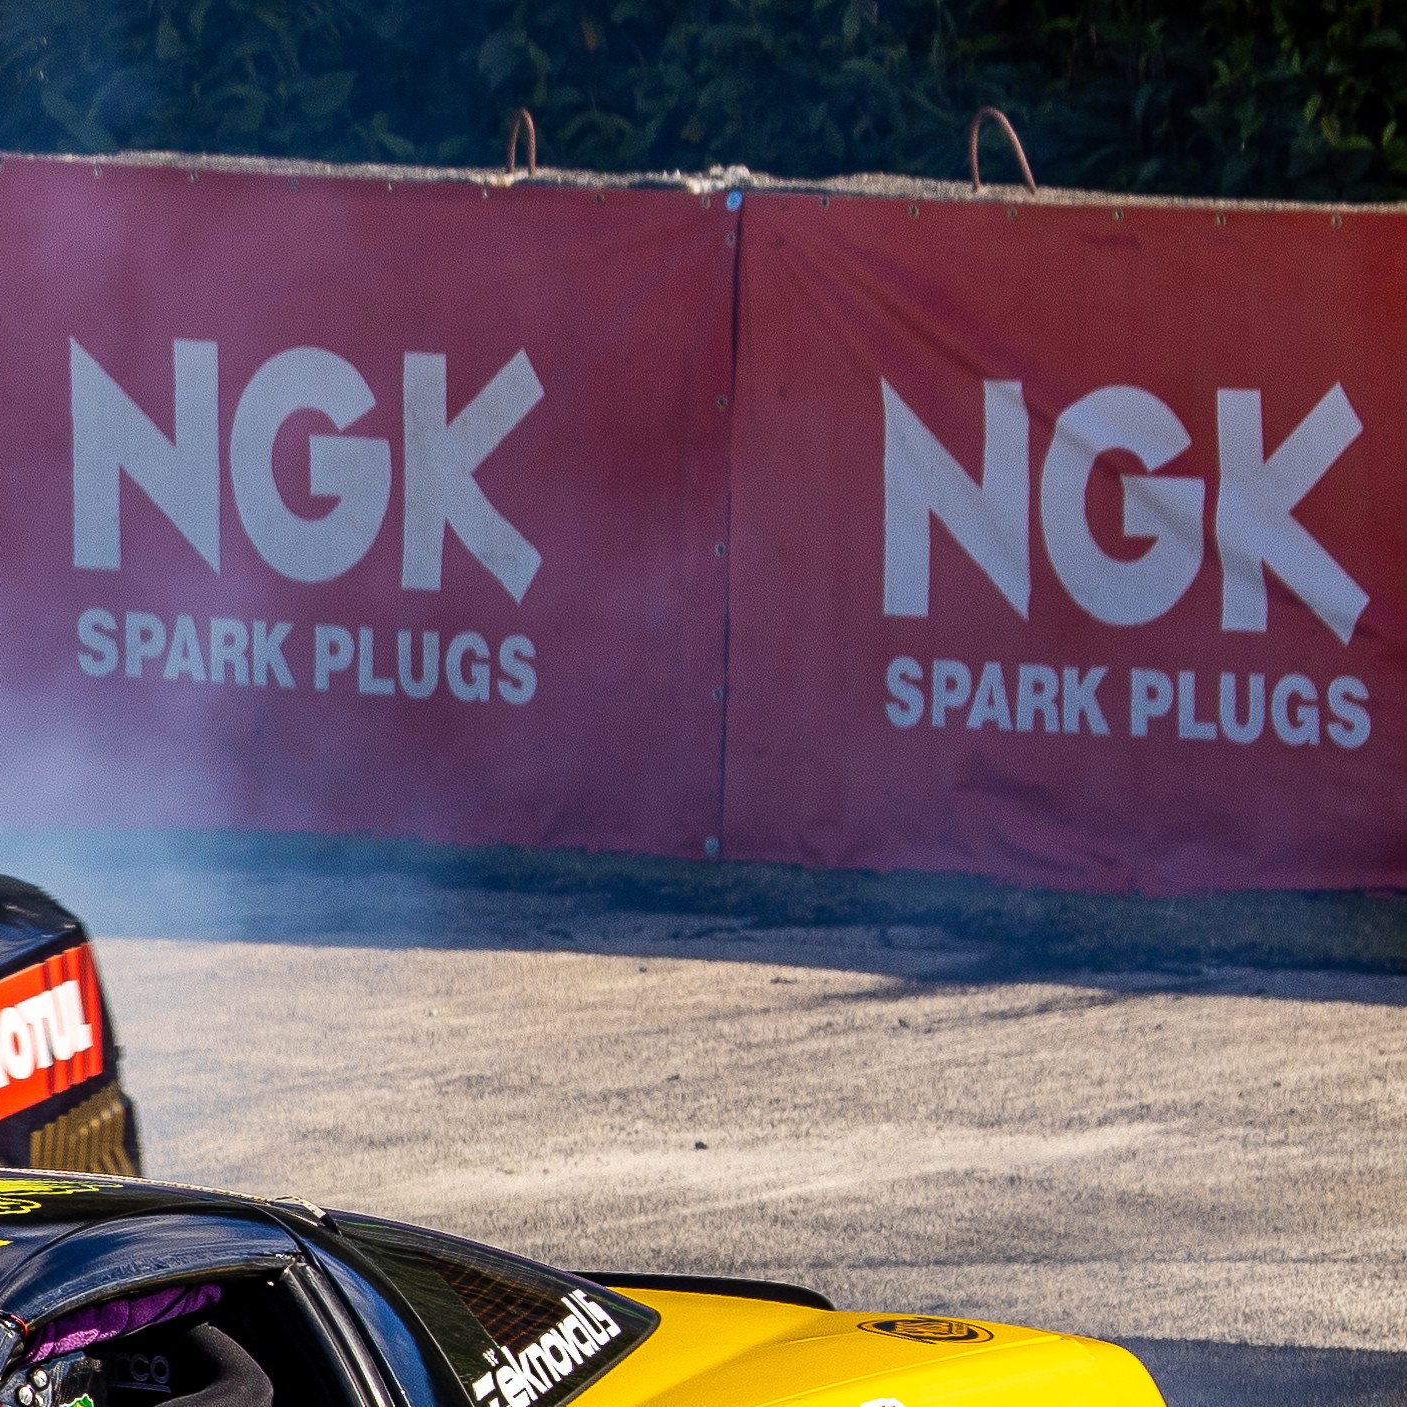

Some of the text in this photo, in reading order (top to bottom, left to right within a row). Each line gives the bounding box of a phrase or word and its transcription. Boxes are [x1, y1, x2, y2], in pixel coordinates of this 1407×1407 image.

[69, 335, 546, 606] NGK
[880, 375, 1371, 647] NGK
[76, 608, 539, 705] SPARK PLUGS
[885, 655, 1372, 750] SPARK PLUGS
